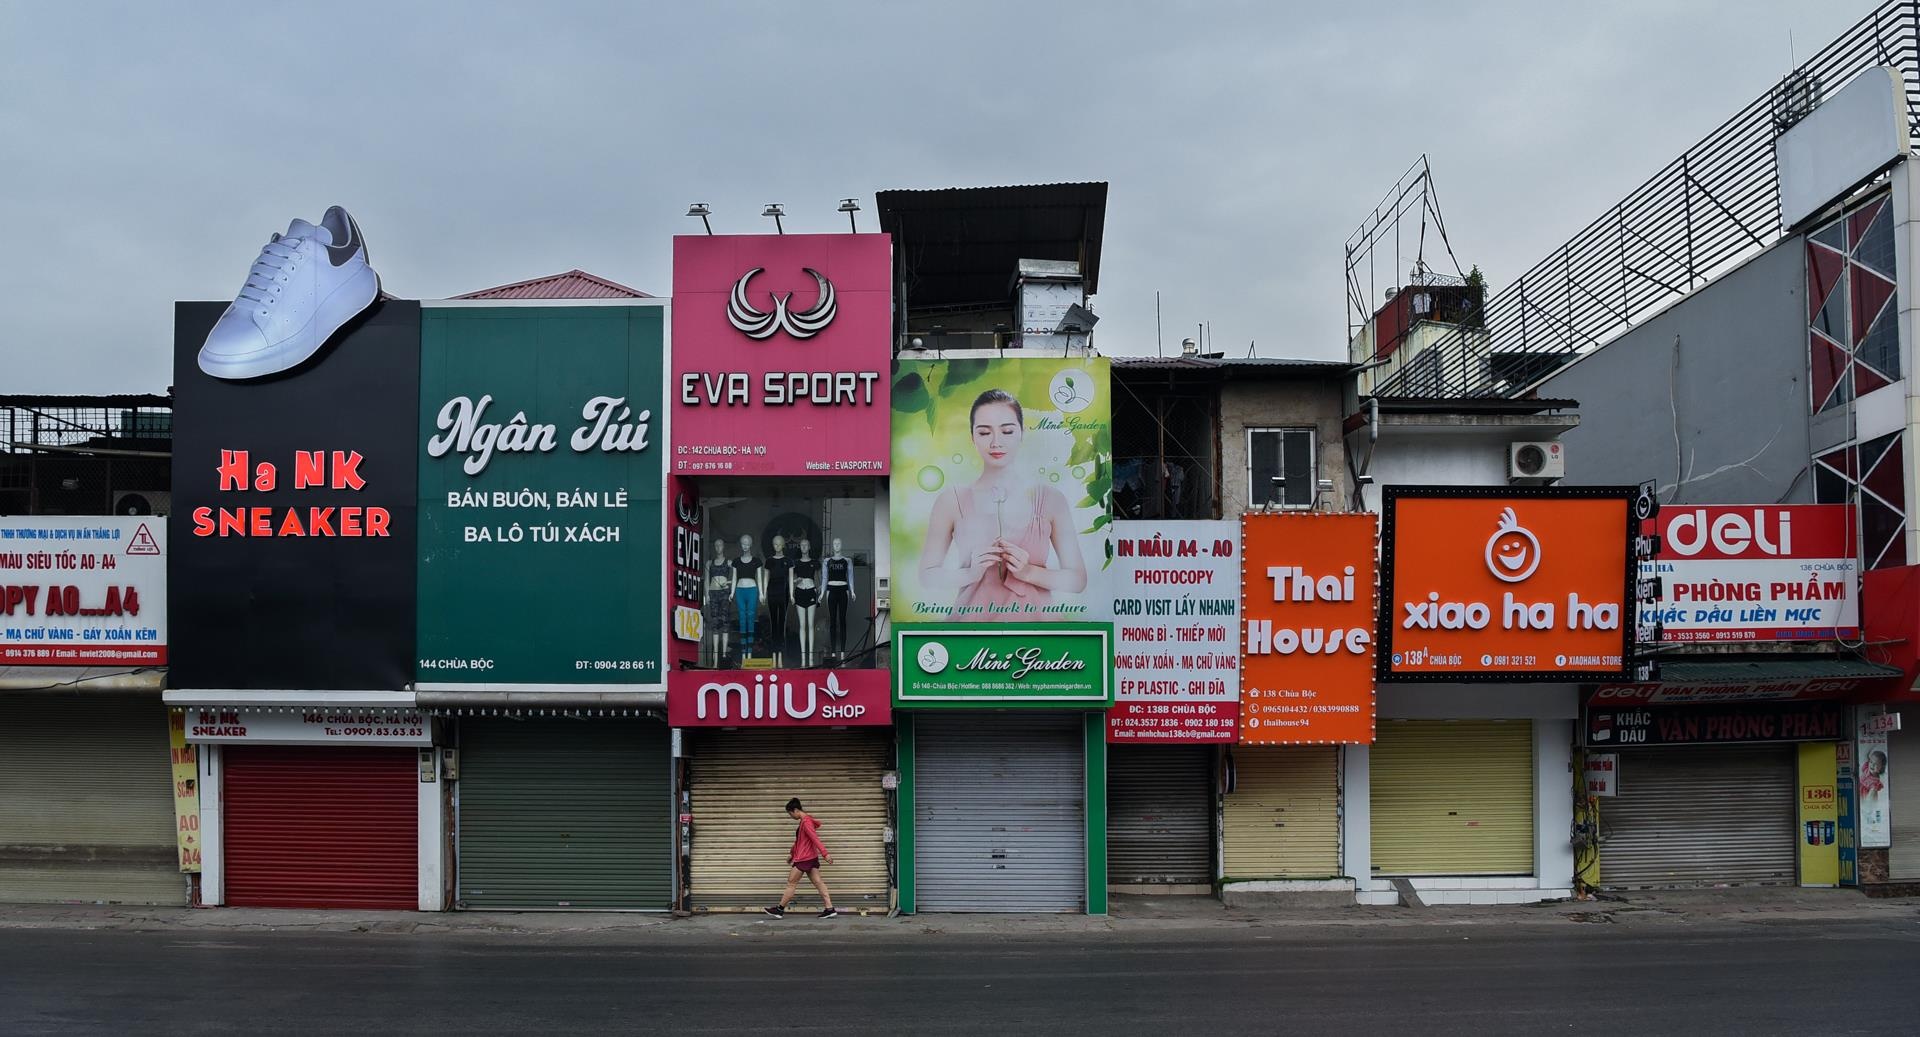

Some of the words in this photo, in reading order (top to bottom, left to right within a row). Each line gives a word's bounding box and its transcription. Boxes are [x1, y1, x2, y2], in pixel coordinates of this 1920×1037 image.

[682, 373, 749, 405] EVA
[764, 372, 879, 405] SPORT
[1029, 416, 1063, 430] Mini
[427, 394, 557, 476] Ngân
[570, 396, 651, 453] Túi
[692, 446, 702, 455] 142
[216, 448, 277, 492] Ha
[294, 450, 366, 491] NK
[805, 461, 831, 471] Website
[835, 461, 883, 471] EVASPORT.VN
[448, 487, 488, 508] BÁN
[492, 487, 551, 510] BUÔN,
[556, 487, 598, 508] BÁN
[604, 487, 628, 508] LẺ
[192, 506, 392, 537] SNEAKER
[1, 528, 14, 539] TNHH
[16, 527, 36, 540] THƯƠNG
[38, 528, 48, 541] MẠI
[55, 528, 67, 541] DỊCH
[77, 528, 82, 539] IN
[464, 526, 493, 542] BA
[497, 523, 524, 542] LÔ
[529, 523, 559, 542] TÚI
[564, 523, 620, 542] XÁCH
[1666, 509, 1792, 556] deli
[677, 525, 700, 571] EVA
[1118, 539, 1134, 557] IN
[1177, 539, 1198, 557] A4
[0, 550, 22, 569] MÀU
[27, 550, 51, 569] SIÊU
[55, 548, 76, 569] TỐC
[1814, 561, 1835, 571] CHÙA
[677, 570, 701, 601] SPORT
[1134, 569, 1214, 585] PHOTOCOPY
[1266, 565, 1355, 601] Thai
[1673, 578, 1761, 602] PHÒNG
[1770, 572, 1846, 601] PHẨM
[911, 601, 952, 615] Bring
[958, 604, 983, 615] you
[988, 602, 1020, 614] back
[1024, 602, 1037, 613] to
[1042, 602, 1088, 613] nature
[1113, 598, 1142, 616] CARD
[1145, 599, 1172, 616] VISIT
[1175, 592, 1196, 616] LẤY
[1199, 599, 1235, 616] NHANH
[1402, 592, 1491, 630] xiao
[1502, 592, 1555, 630] ha
[1567, 592, 1620, 630] ha
[1639, 603, 1687, 624] KHẮC
[1695, 605, 1732, 623] DẤU
[1739, 603, 1777, 622] LIỀN
[1784, 607, 1822, 625] MỰC
[6, 628, 22, 642] MẠ
[25, 626, 45, 640] CHỮ
[48, 626, 73, 640] VÀNG
[83, 627, 101, 640] GÁY
[105, 625, 132, 640] XOẮN
[679, 610, 700, 640] 142
[1122, 627, 1154, 642] PHONG
[1157, 623, 1167, 642] BÌ
[1176, 622, 1205, 642] THIẾP
[1207, 624, 1226, 642] MỜI
[1247, 619, 1371, 655] House
[1677, 632, 1695, 640] 3533
[1715, 632, 1731, 640] 0913
[56, 649, 78, 658] Email:
[1134, 651, 1151, 670] GÁY
[1153, 648, 1174, 670] XOẮN
[1181, 655, 1194, 673] MẠ
[1196, 652, 1213, 670] CHỮ
[1215, 651, 1236, 670] VÀNG
[1430, 653, 1446, 665] CHÙA
[1494, 655, 1509, 665] 0981
[1602, 655, 1622, 665] STORE
[419, 659, 437, 669] 144
[438, 656, 468, 669] CHÙA
[470, 657, 494, 672] BỘC
[576, 660, 593, 670] ĐT:
[594, 660, 617, 670] 0904
[619, 660, 631, 670] 28
[632, 660, 645, 670] 66
[646, 660, 655, 670] 11
[956, 647, 1014, 670] Mini
[1011, 647, 1086, 679] Garden
[1121, 676, 1134, 695] ÉP
[1138, 681, 1179, 695] PLASTIC
[1188, 681, 1205, 695] GHI
[1208, 677, 1225, 695] ĐĨA
[1263, 690, 1276, 698] 138
[1278, 687, 1299, 698] Chùa
[1301, 689, 1317, 700] Bộc
[1597, 686, 1657, 699] deli
[1804, 681, 1859, 693] deli
[697, 674, 817, 719] miiu
[822, 704, 865, 718] SHOP
[1129, 706, 1144, 714] ĐC:
[1147, 706, 1169, 714] 138B
[1171, 703, 1195, 714] CHÙA
[1198, 704, 1217, 715] BỘC
[1263, 704, 1308, 713] 0965104432
[1616, 707, 1651, 726] KHẮC
[303, 713, 324, 724] 146
[327, 712, 355, 724] CHÙA
[386, 713, 400, 724] HÀ
[404, 714, 422, 726] NỘI
[1111, 719, 1123, 727] ĐT:
[1125, 719, 1158, 727] 024.3537
[1160, 719, 1178, 727] 1836
[1184, 719, 1203, 727] 0902
[1205, 719, 1218, 727] 180
[1220, 719, 1234, 727] 198
[1656, 711, 1699, 742] VĂN
[1704, 709, 1777, 741] PHÒNG
[1779, 704, 1839, 738] PHẨM
[1874, 716, 1893, 730] 134
[192, 726, 247, 736] SNEAKER
[344, 727, 423, 736] 0909.83.63.83
[1114, 730, 1136, 738] Email:
[1137, 729, 1231, 739] minhchau138cb@gmail.com
[1620, 726, 1647, 743] DẤU
[1806, 789, 1832, 800] 136
[182, 848, 201, 865] A4
